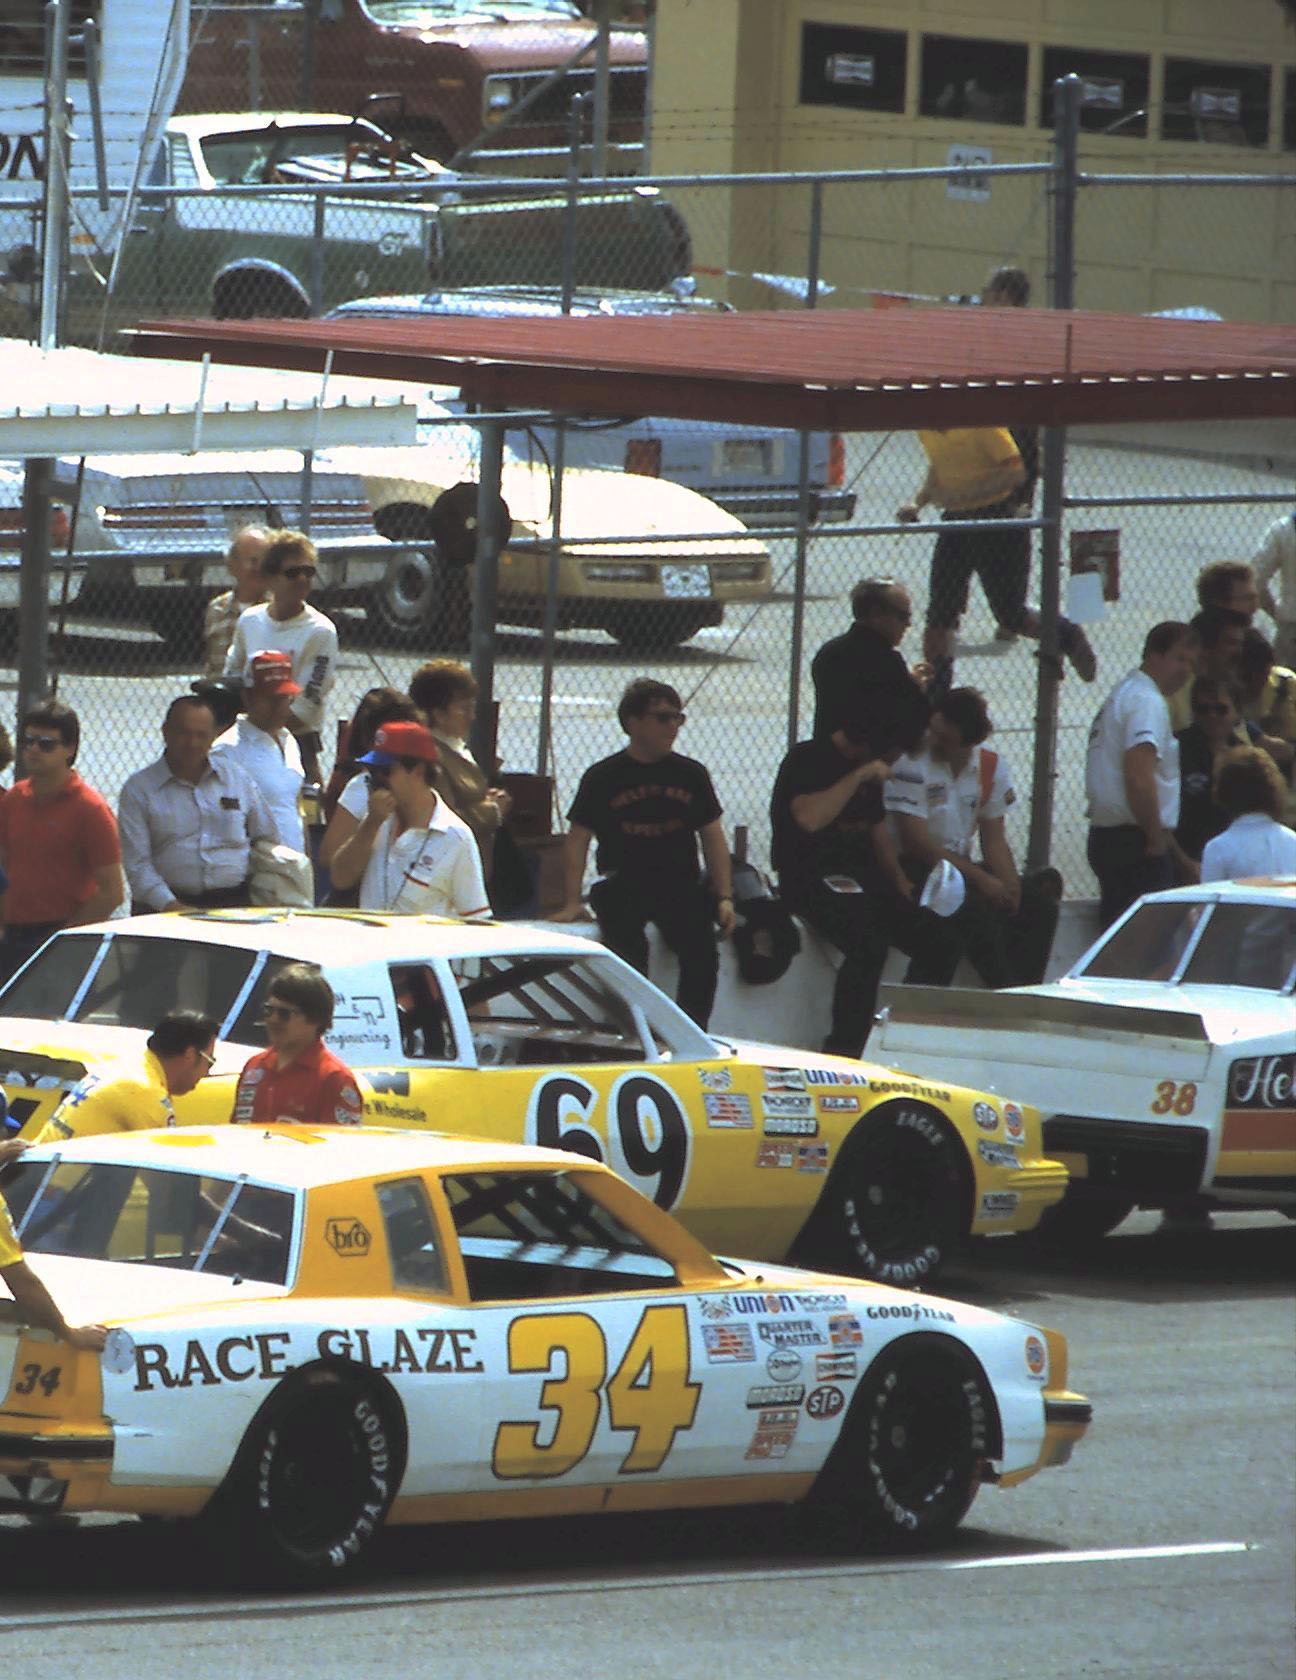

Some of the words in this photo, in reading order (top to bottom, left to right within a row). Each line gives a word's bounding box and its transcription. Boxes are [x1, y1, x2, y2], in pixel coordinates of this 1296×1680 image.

[870, 1080, 952, 1103] GOODYEAR
[1152, 1080, 1198, 1117] 38
[525, 1072, 691, 1213] 69
[866, 1303, 957, 1323] GOODYEAR
[133, 1333, 292, 1392] RACE
[316, 1329, 485, 1374] GLAZE
[14, 1363, 62, 1397] 34
[491, 1303, 702, 1481] 34
[808, 1387, 841, 1413] STP
[329, 1400, 389, 1567] GOODYEAR
